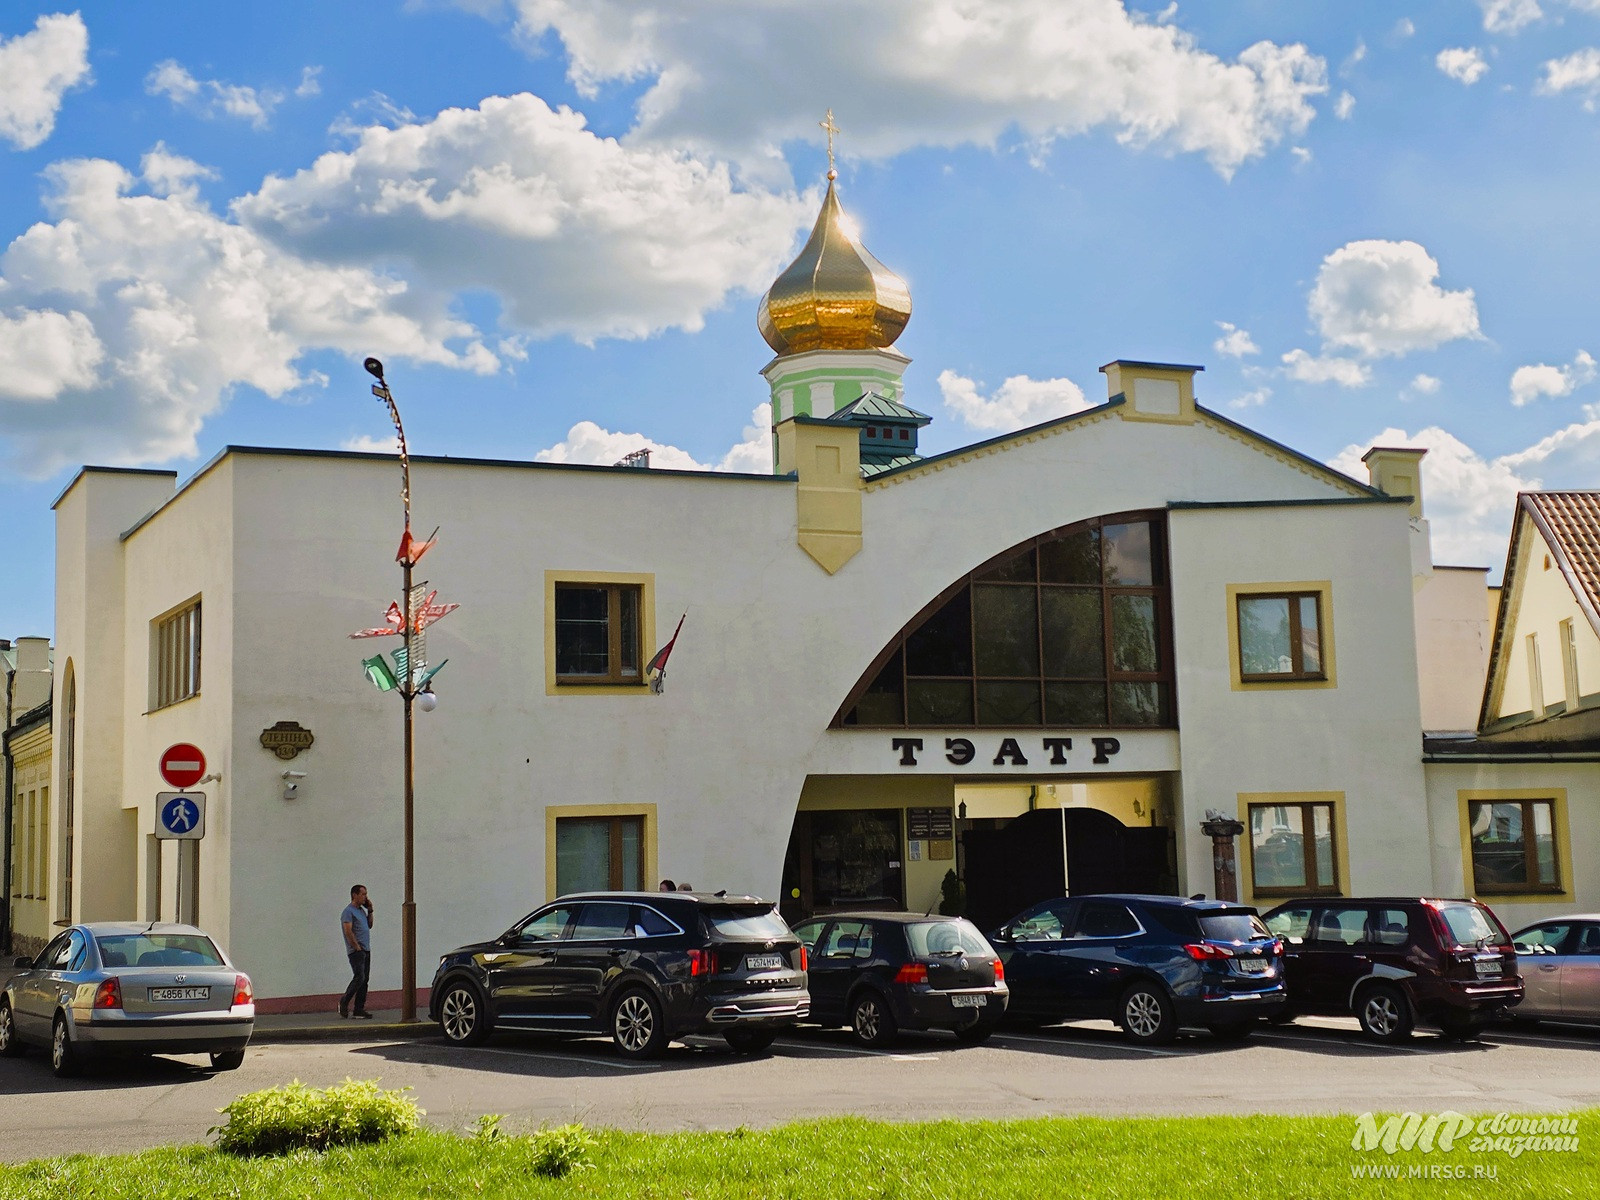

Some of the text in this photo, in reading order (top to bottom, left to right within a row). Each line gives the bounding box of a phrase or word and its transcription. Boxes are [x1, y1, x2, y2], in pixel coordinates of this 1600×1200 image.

[892, 737, 1121, 765] ТЭАТР
[161, 989, 207, 999] 4856 KT-4
